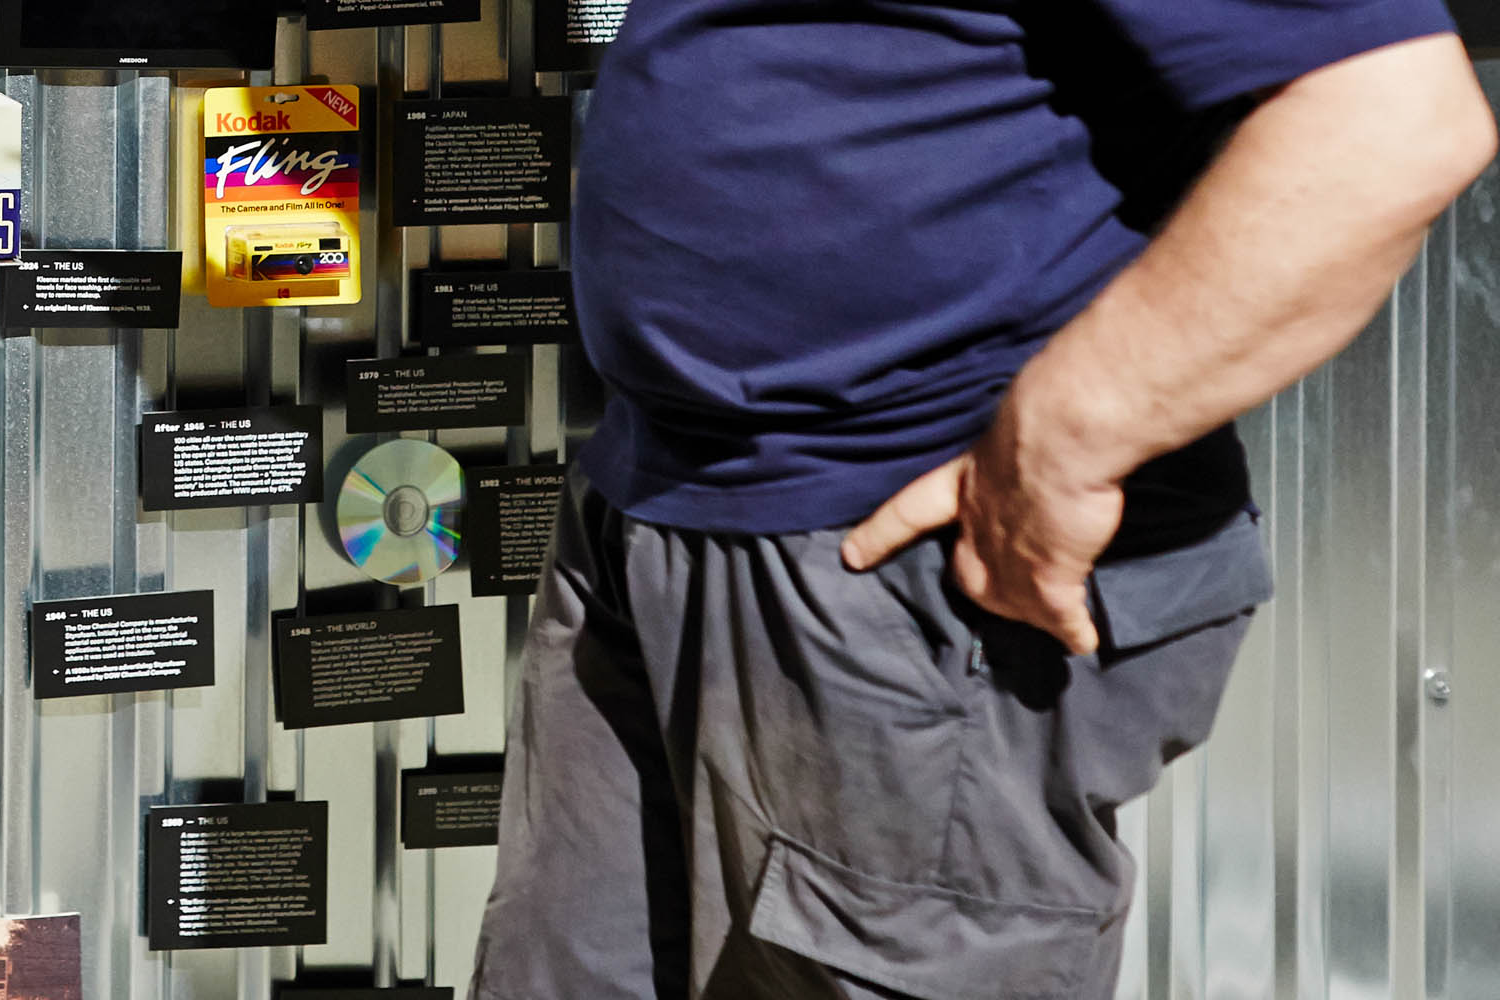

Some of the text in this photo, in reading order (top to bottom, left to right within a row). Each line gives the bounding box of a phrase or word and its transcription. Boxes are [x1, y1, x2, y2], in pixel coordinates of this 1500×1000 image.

[323, 90, 353, 116] NEW
[216, 110, 291, 133] Kodak
[215, 137, 349, 200] Fling
[221, 205, 236, 213] The
[237, 204, 268, 213] Camera
[270, 203, 284, 211] and
[285, 202, 303, 211] Film
[304, 202, 315, 210] All
[325, 200, 345, 209] One!
[296, 241, 312, 249] Fling
[319, 252, 345, 264] 200
[154, 423, 180, 432] After
[220, 420, 237, 429] THE
[238, 419, 251, 428] US
